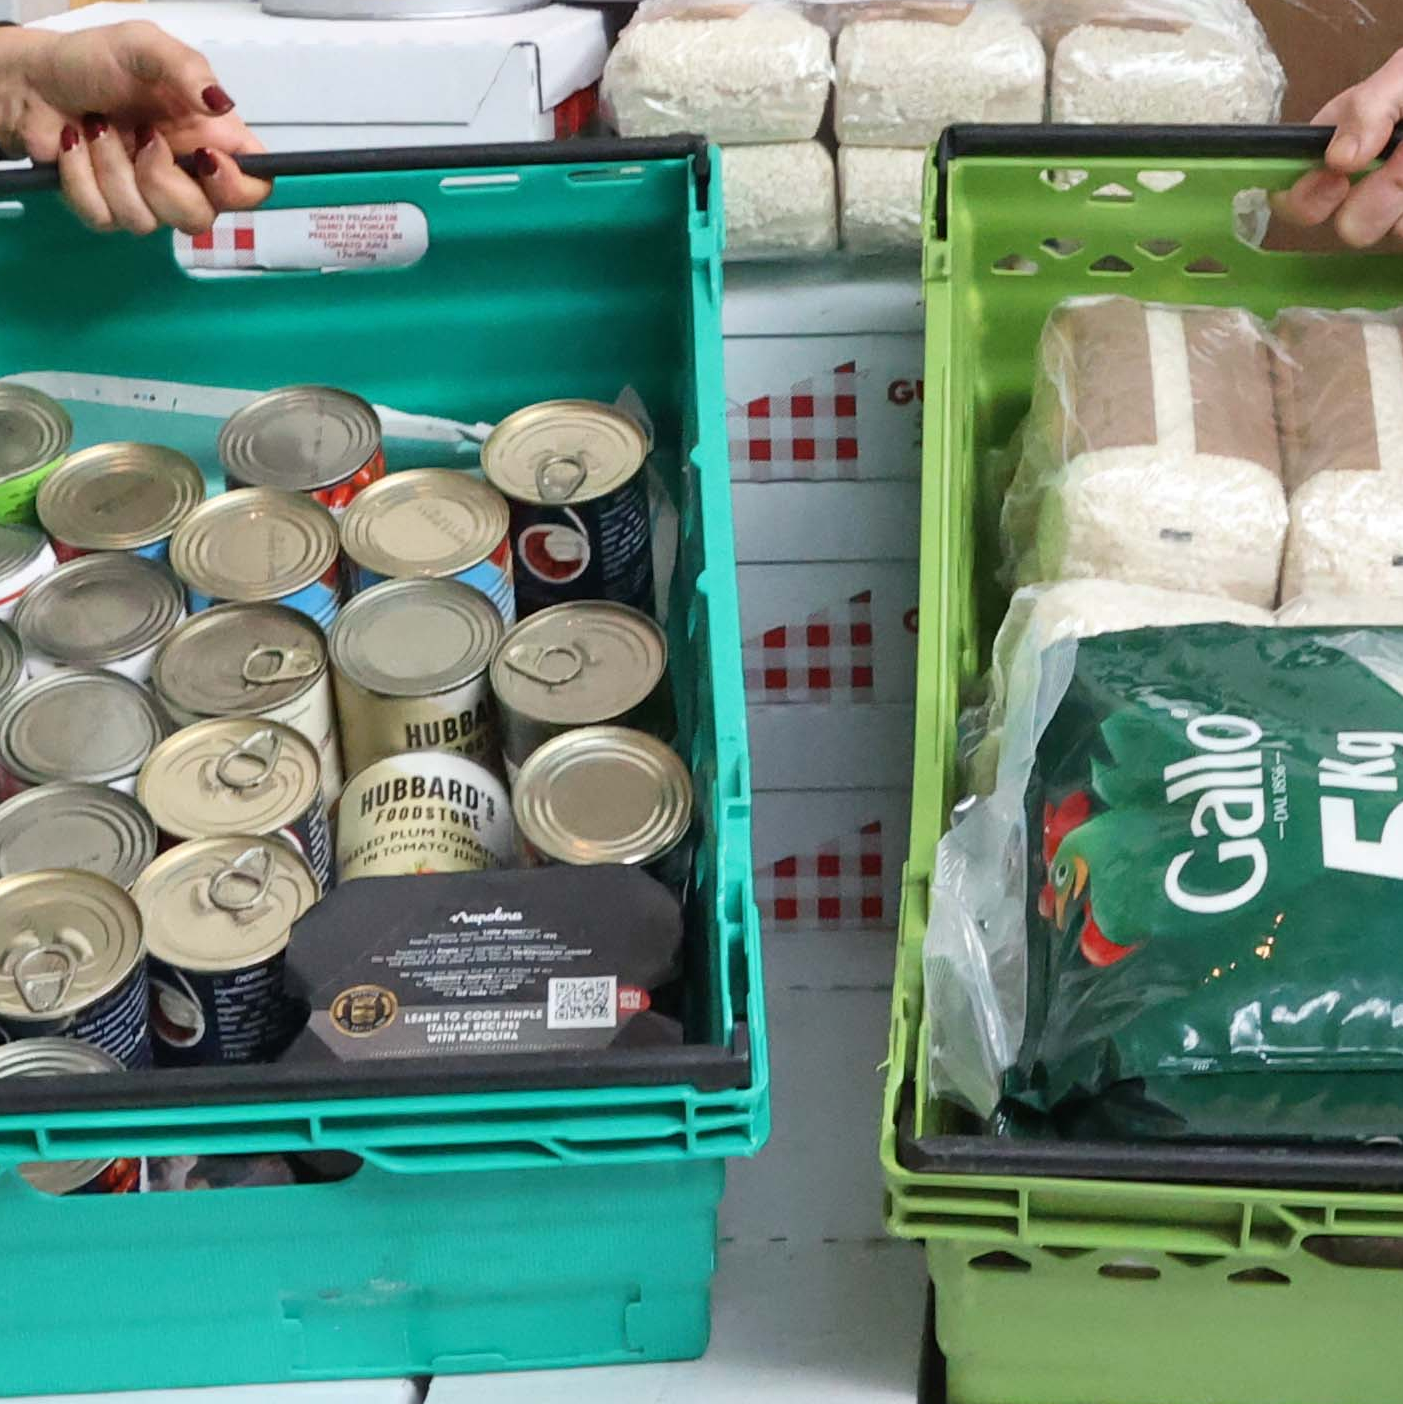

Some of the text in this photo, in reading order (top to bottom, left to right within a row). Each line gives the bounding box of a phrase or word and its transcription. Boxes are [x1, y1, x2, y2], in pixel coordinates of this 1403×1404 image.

[360, 776, 496, 824] HUBBARD'S
[1272, 764, 1290, 822] DAL 1856
[374, 805, 482, 832] FOODSTORE
[1164, 714, 1268, 913] Gallo
[390, 826, 436, 842] PLUM
[363, 851, 378, 866] IN
[384, 842, 449, 857] TOMATO
[404, 1009, 543, 1024] LEARN TO COOK SIMPLE
[426, 1020, 520, 1033] ITALIAN RECIPES
[426, 1031, 519, 1044] WITH NAPOLINA
